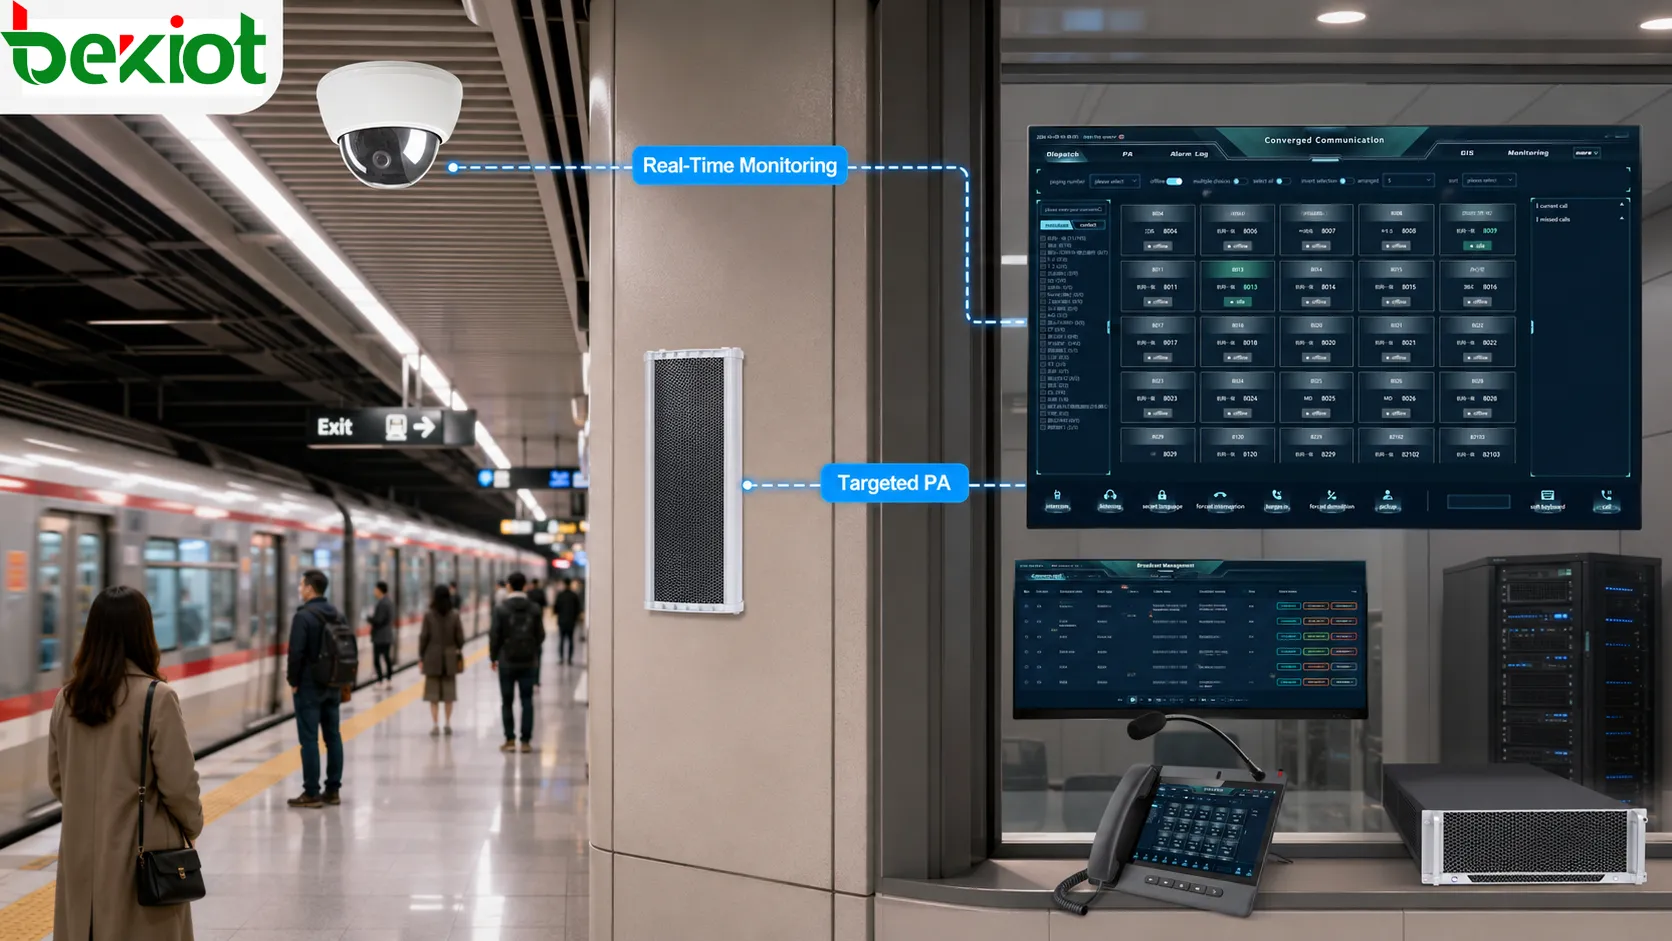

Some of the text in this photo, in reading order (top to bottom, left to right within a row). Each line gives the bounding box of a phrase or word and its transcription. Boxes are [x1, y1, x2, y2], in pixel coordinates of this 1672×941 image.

[1264, 136, 1385, 146] Converged Communication
[1046, 150, 1080, 159] Dispatch
[1194, 151, 1209, 159] Log
[1507, 149, 1550, 158] Monitoring
[317, 417, 353, 436] Exit
[1162, 562, 1195, 570] Management
